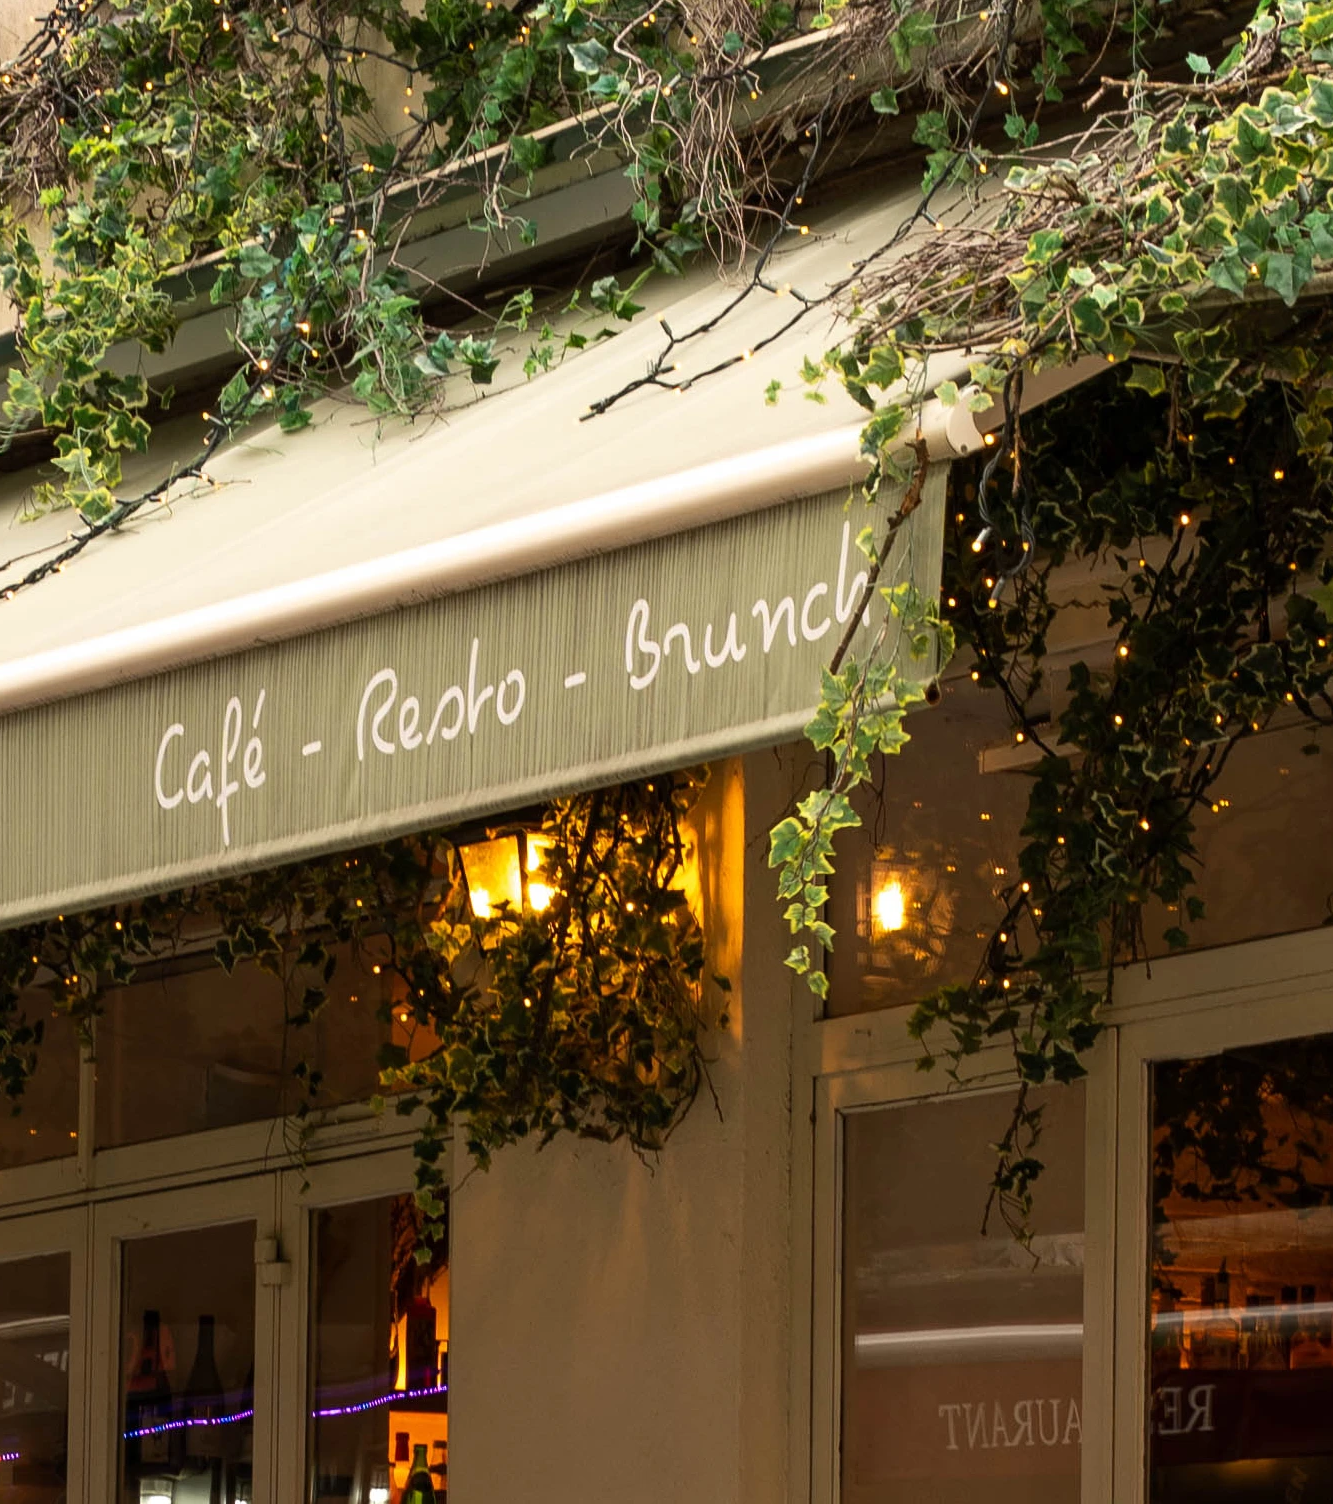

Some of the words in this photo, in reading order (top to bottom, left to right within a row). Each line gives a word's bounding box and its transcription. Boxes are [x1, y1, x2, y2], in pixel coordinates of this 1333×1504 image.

[154, 688, 267, 848] Café
[357, 636, 527, 760] Resto
[625, 520, 871, 691] Brunch
